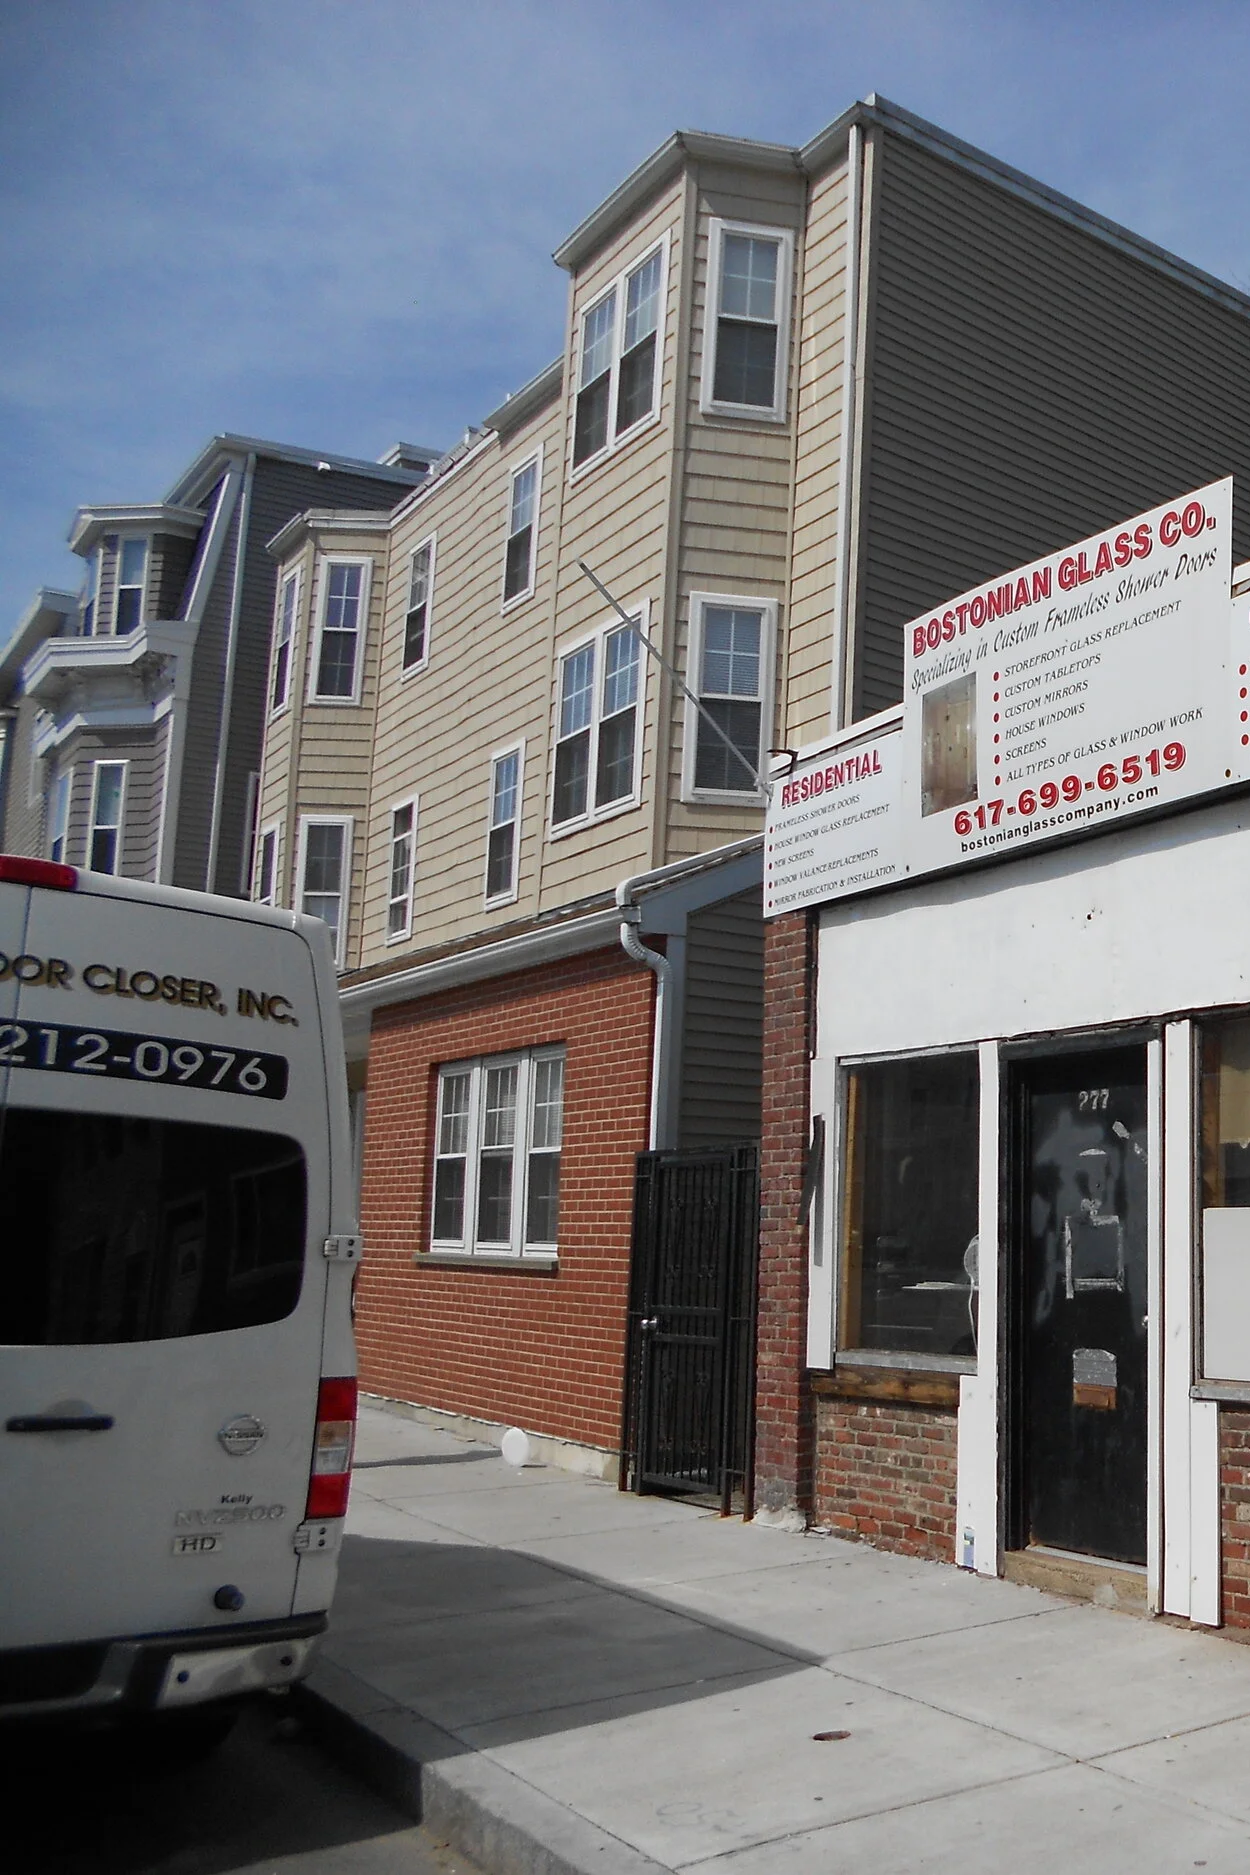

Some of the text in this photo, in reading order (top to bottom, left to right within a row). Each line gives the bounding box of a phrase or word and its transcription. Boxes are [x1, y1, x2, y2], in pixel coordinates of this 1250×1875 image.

[913, 500, 1216, 658] BOSTONIAN GLASS CO.
[911, 547, 1217, 696] Specializing in Custom Frameless Shower Doors
[1004, 600, 1182, 678] STOREFRONT GLASS REPLACEMENT
[1004, 653, 1101, 698] CUSTOM TABLETOPS
[1004, 679, 1088, 719] CUSTOM MIRRORS
[1005, 703, 1085, 740] HOUSE WINDOWS
[1005, 738, 1047, 761] SCREENS
[1006, 707, 1203, 783] ALL TYPES OF GLASS & WINDOW WORK
[781, 749, 882, 809] RESIDENTIAL
[954, 741, 1187, 837] 617-699-6519
[774, 794, 861, 832] FRAMELESS SHOWER DOORS
[774, 804, 890, 851] HOUSE WINDOW GLASS REPLACEMENT
[961, 786, 1159, 853] bostonianglasscompany.com
[774, 848, 815, 868] NEW SCREENS
[774, 873, 797, 888] WINDOW
[827, 848, 879, 871] REPLACEMENTS
[798, 881, 838, 900] FABRICATION
[839, 879, 845, 888] &
[847, 864, 896, 886] INSTALLATION
[0, 952, 299, 1027] OR CLOSER, INC.
[0, 1023, 267, 1091] 212-0976
[1079, 1088, 1110, 1110] 277
[221, 1494, 253, 1504] Kelly
[181, 1536, 217, 1551] HD
